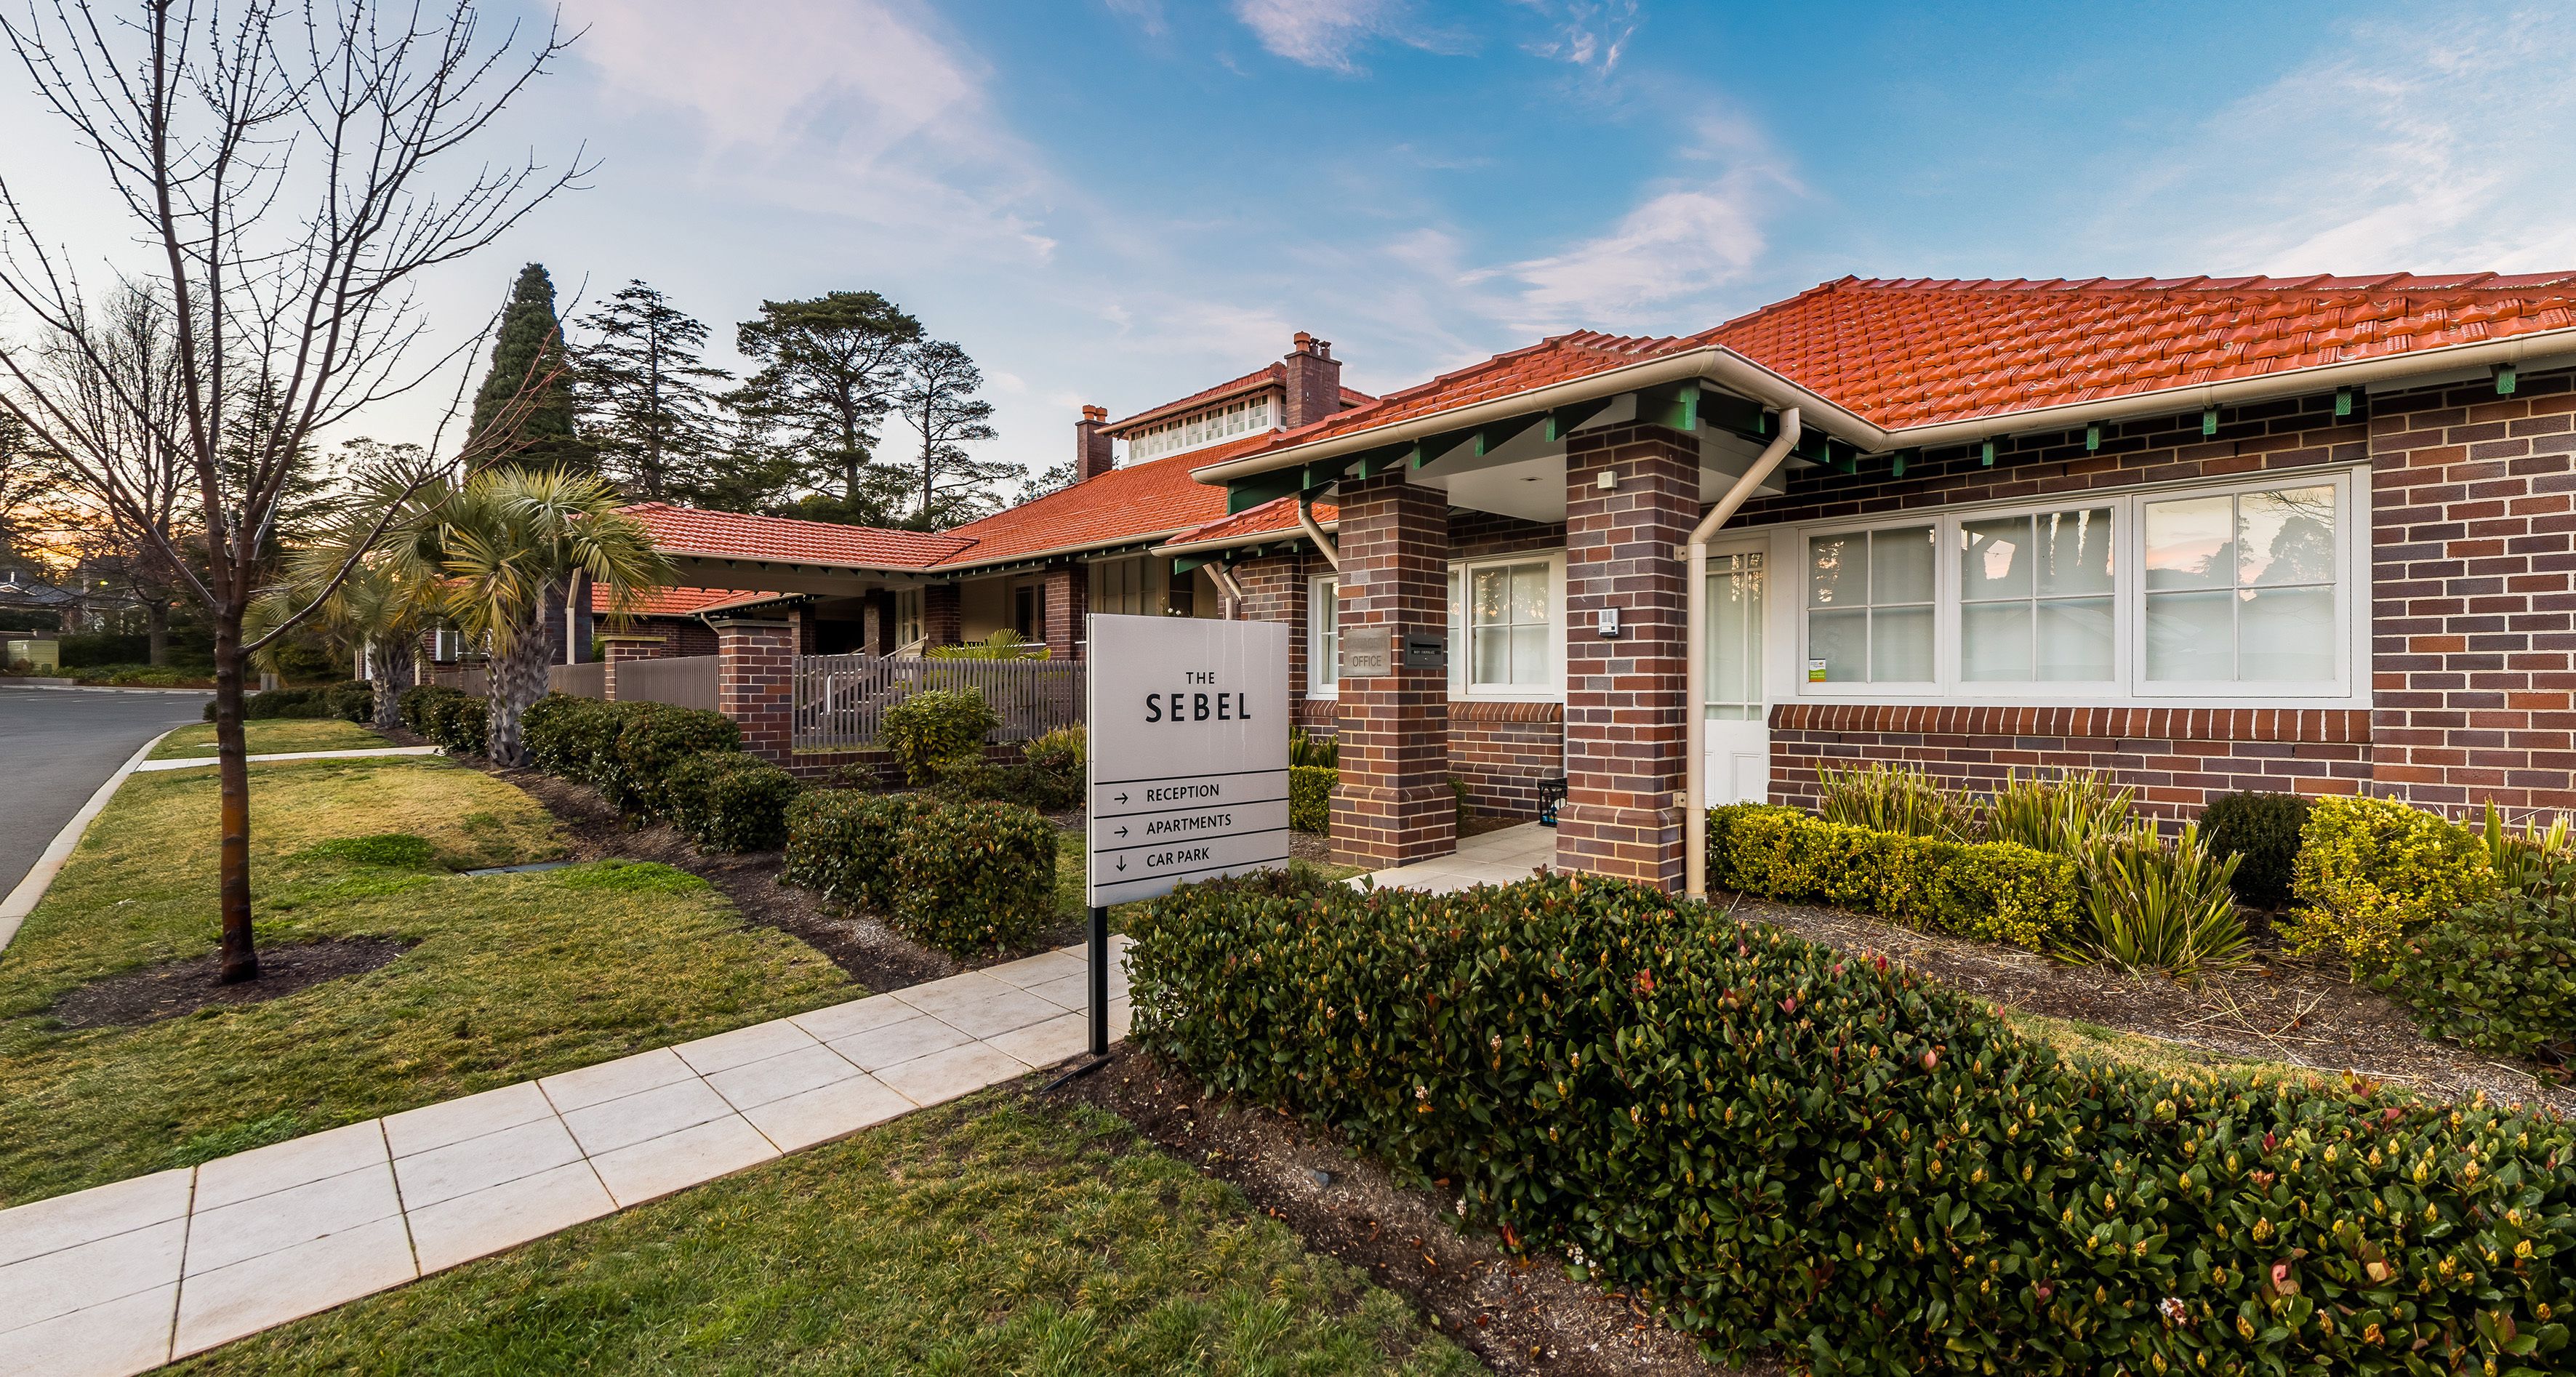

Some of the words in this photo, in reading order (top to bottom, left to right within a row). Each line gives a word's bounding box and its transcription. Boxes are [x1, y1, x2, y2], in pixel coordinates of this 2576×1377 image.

[1352, 655, 1381, 667] OFFICE
[1186, 672, 1215, 684] THE
[1145, 693, 1251, 723] SEBEL
[1147, 784, 1219, 802] RECEPTION
[1146, 814, 1232, 835] APARTMENTS
[1147, 852, 1174, 867] CAR
[1177, 847, 1210, 864] PARK
